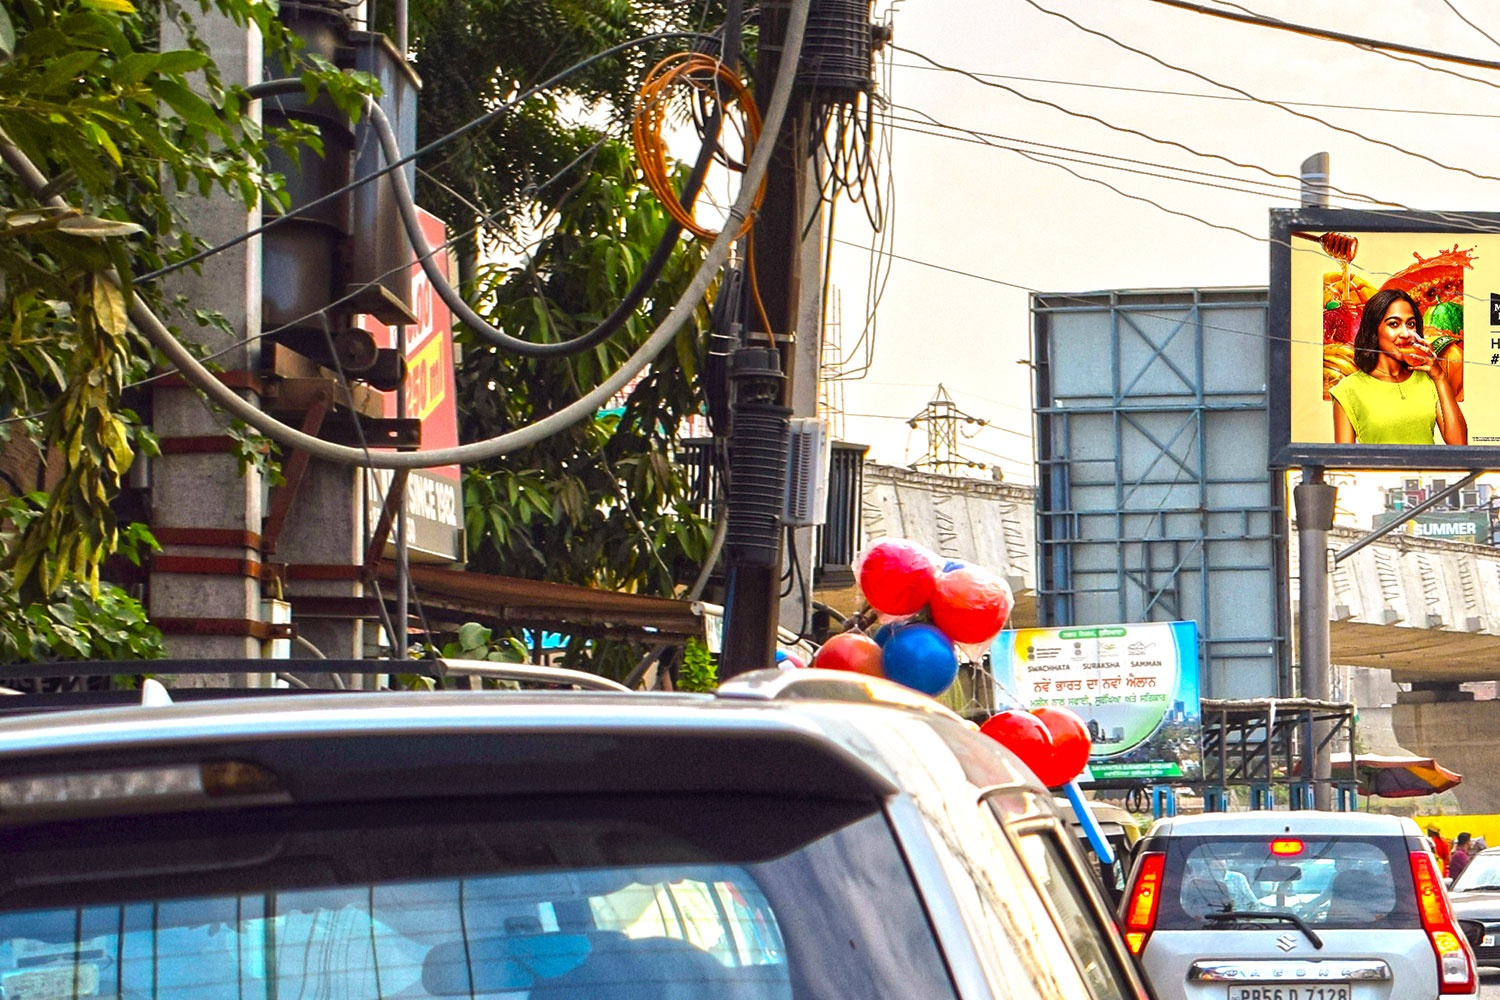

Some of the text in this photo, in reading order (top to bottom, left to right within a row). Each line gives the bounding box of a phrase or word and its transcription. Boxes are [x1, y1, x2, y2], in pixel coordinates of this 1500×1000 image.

[408, 472, 436, 520] SINCE
[1413, 522, 1476, 536] SUMMER
[1027, 664, 1071, 672] SWACHHATA
[1130, 660, 1162, 668] SAMMAN
[1055, 680, 1082, 691] ਭਾਰਤ
[1086, 679, 1098, 690] ਦਾ
[1102, 675, 1121, 689] ਨਵਾਂ
